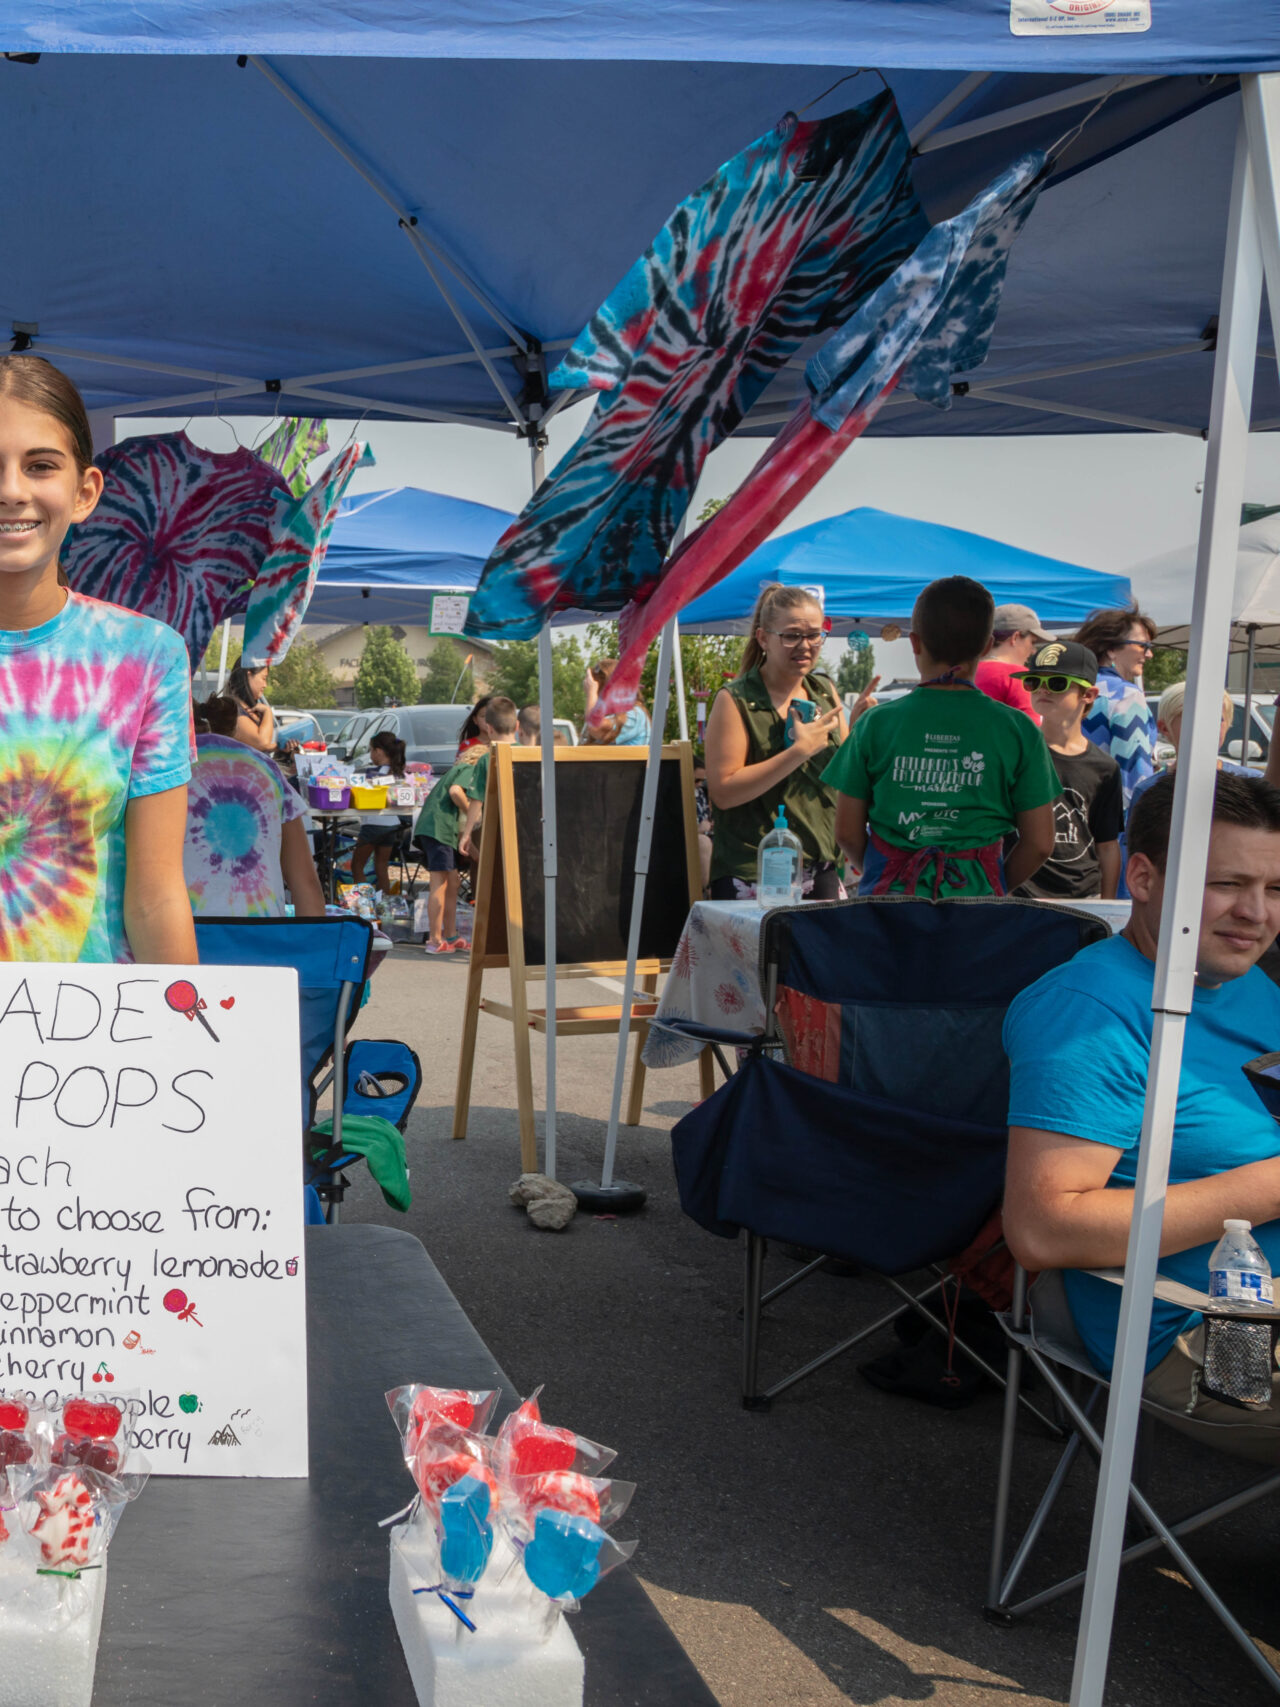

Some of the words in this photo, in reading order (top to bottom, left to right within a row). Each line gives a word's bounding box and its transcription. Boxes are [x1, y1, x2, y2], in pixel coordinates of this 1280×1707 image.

[910, 780, 962, 793] market
[1, 1196, 40, 1231] to
[57, 1196, 164, 1233] choose
[182, 1187, 270, 1231] from:
[154, 1249, 283, 1280] lemonade
